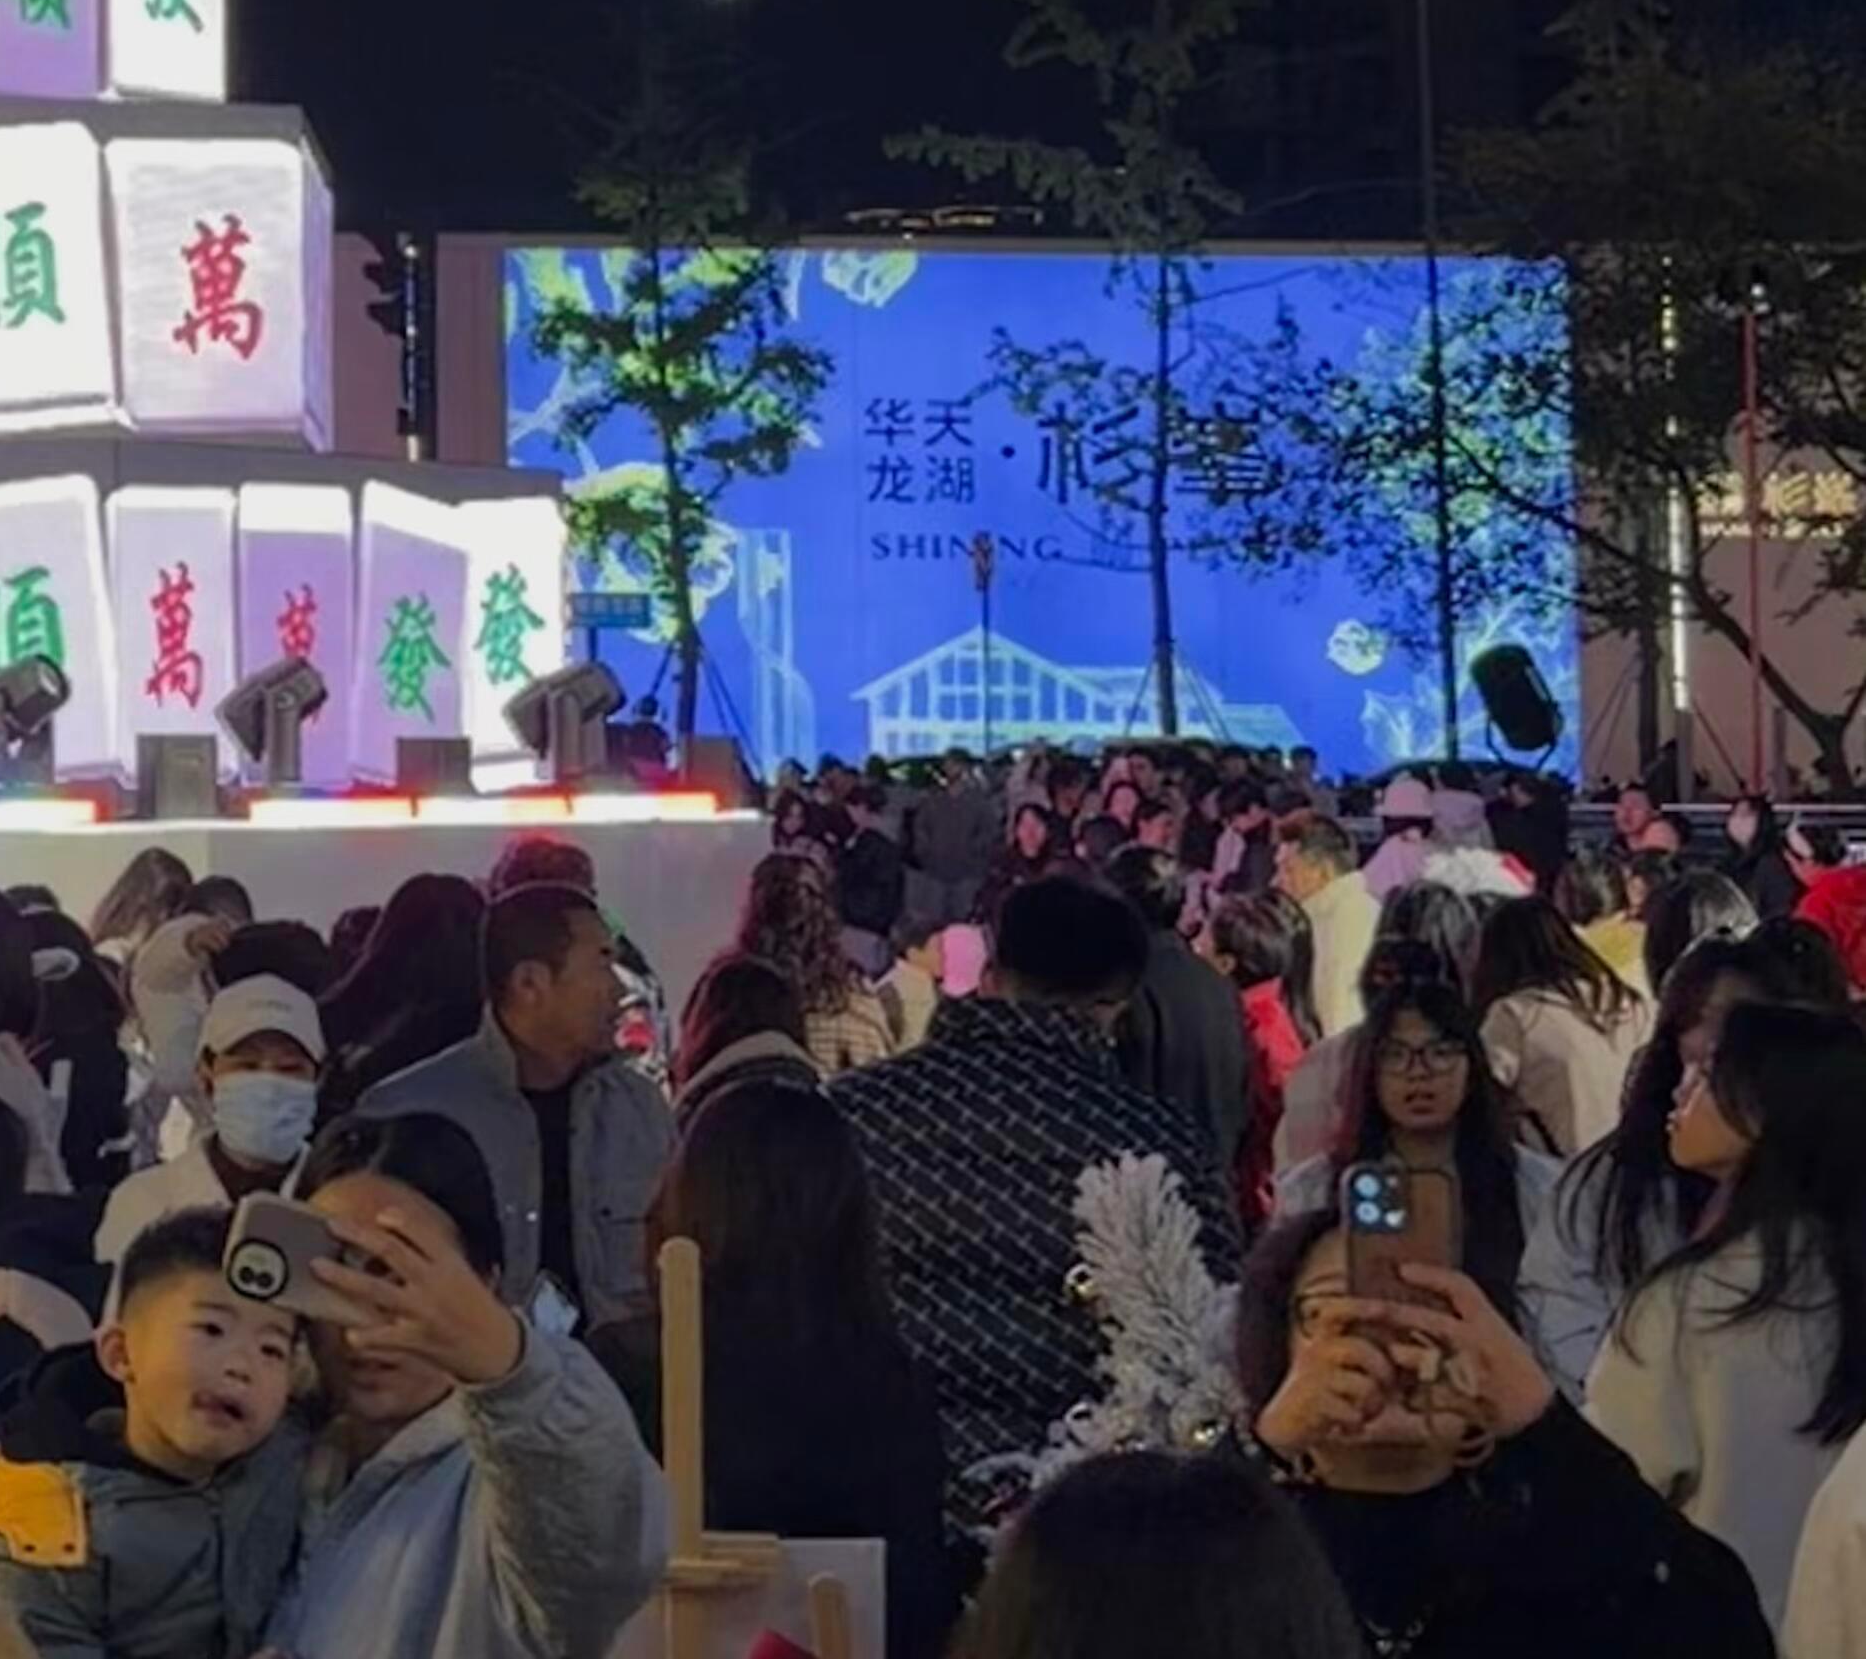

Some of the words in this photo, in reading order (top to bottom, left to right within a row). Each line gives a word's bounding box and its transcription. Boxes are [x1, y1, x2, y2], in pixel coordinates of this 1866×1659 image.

[172, 213, 264, 361] 萬
[863, 397, 974, 449] 华天
[865, 455, 978, 505] 龙湖
[870, 532, 1063, 563] SHINNG
[144, 561, 204, 711] 萬
[377, 591, 452, 722] 發
[472, 562, 546, 686] 發
